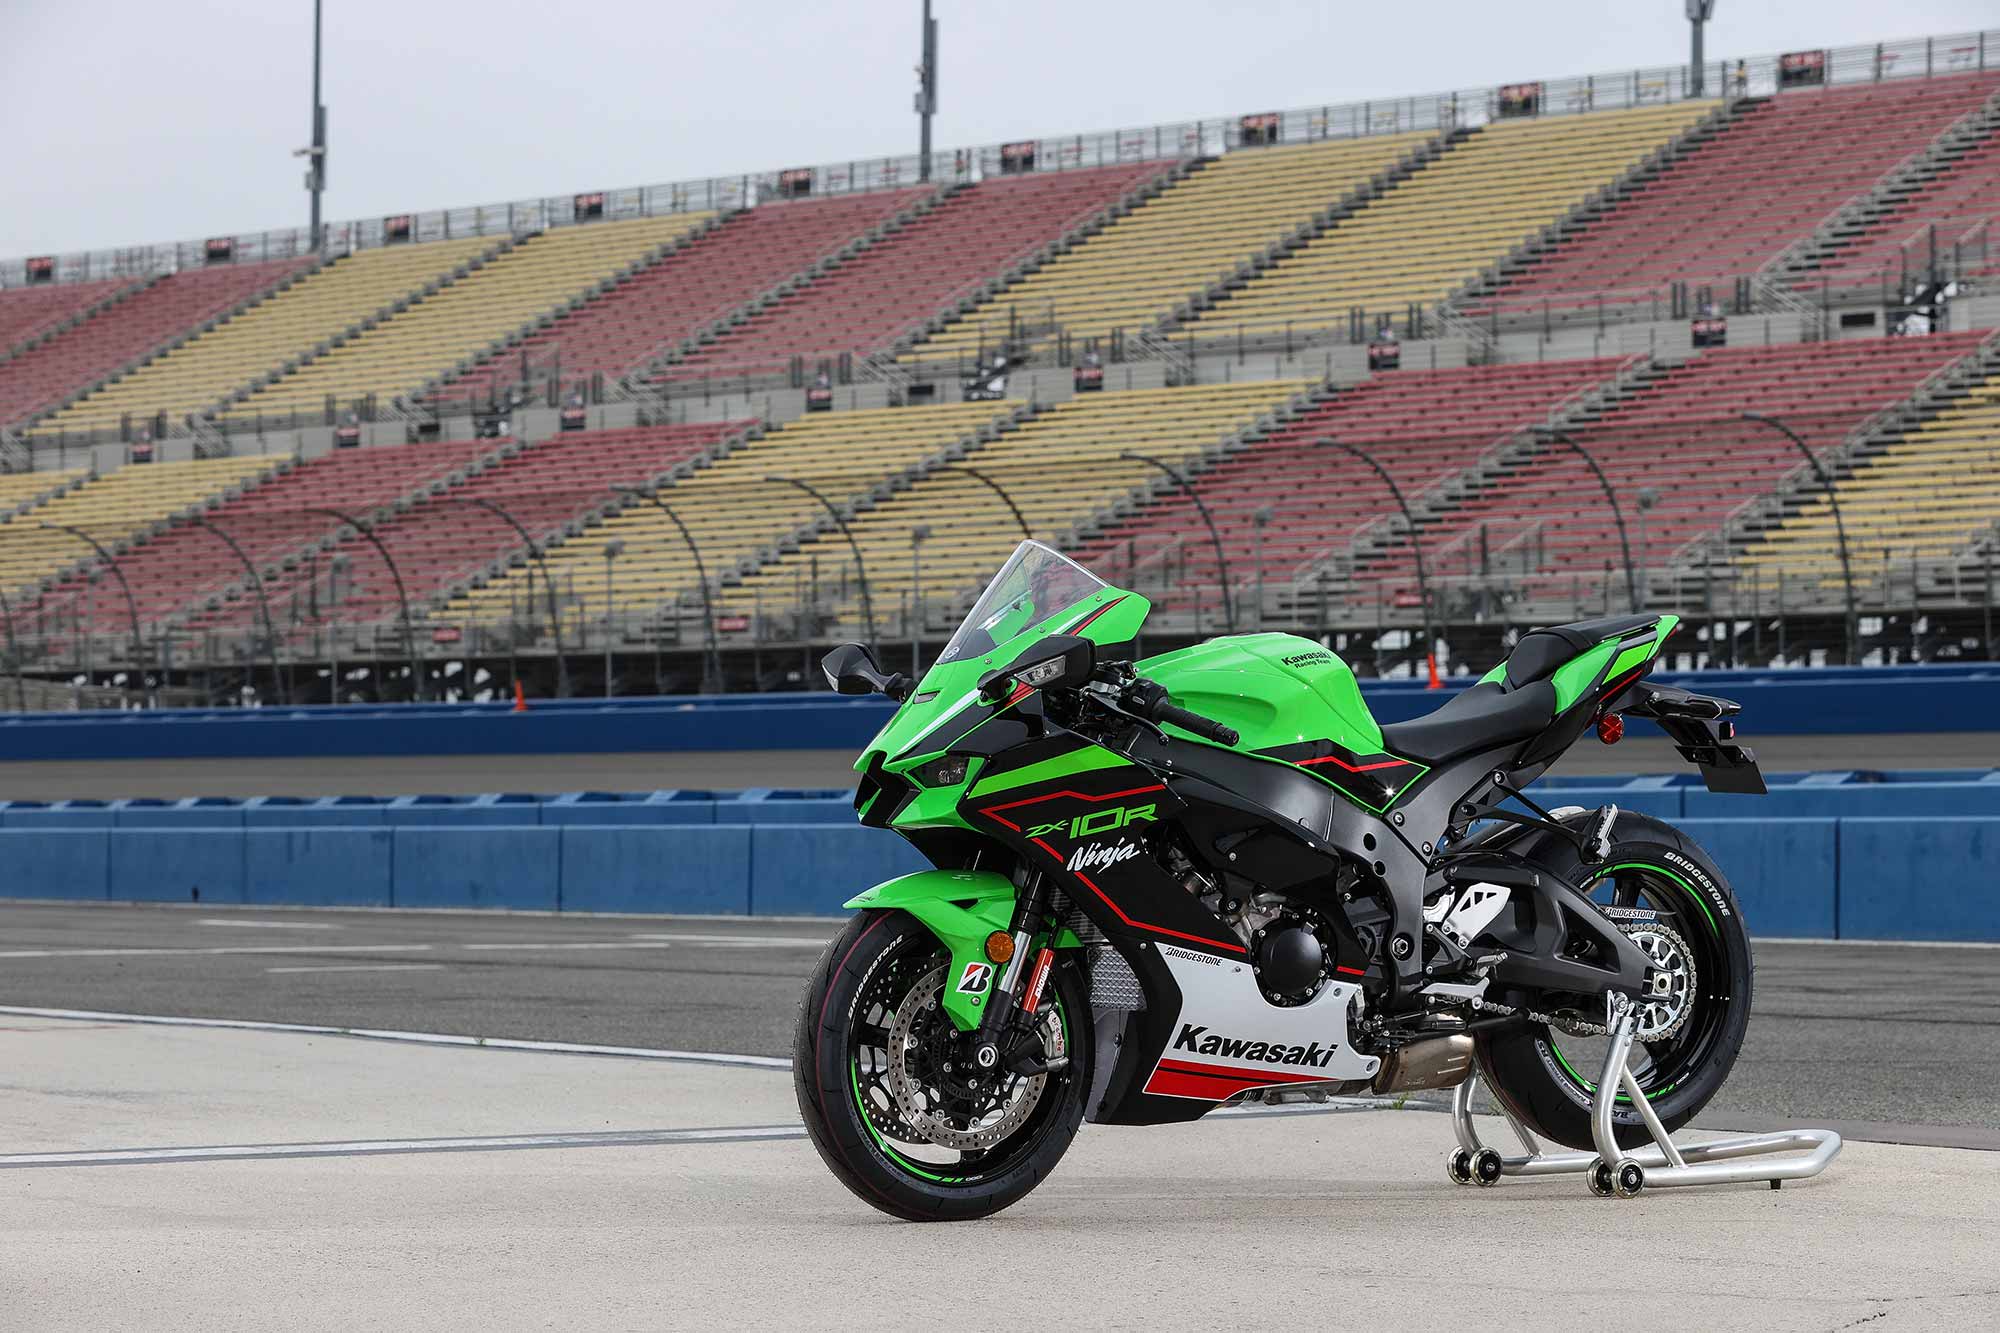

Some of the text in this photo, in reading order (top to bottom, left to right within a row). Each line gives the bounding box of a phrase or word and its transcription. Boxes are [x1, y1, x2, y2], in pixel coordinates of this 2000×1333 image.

[1281, 651, 1331, 666] Kawasaki
[1295, 660, 1317, 668] Racing
[1024, 803, 1159, 839] ZX-10R
[1066, 837, 1140, 874] Ninja
[1664, 851, 1732, 918] BRIDGESTONE
[1605, 907, 1656, 919] BRIDGESTONE
[1165, 947, 1223, 966] BRIDGESTONE
[848, 935, 904, 1018] BRIDGESTONE
[1034, 965, 1050, 999] SHOWA
[1173, 1023, 1338, 1067] Kawasaki
